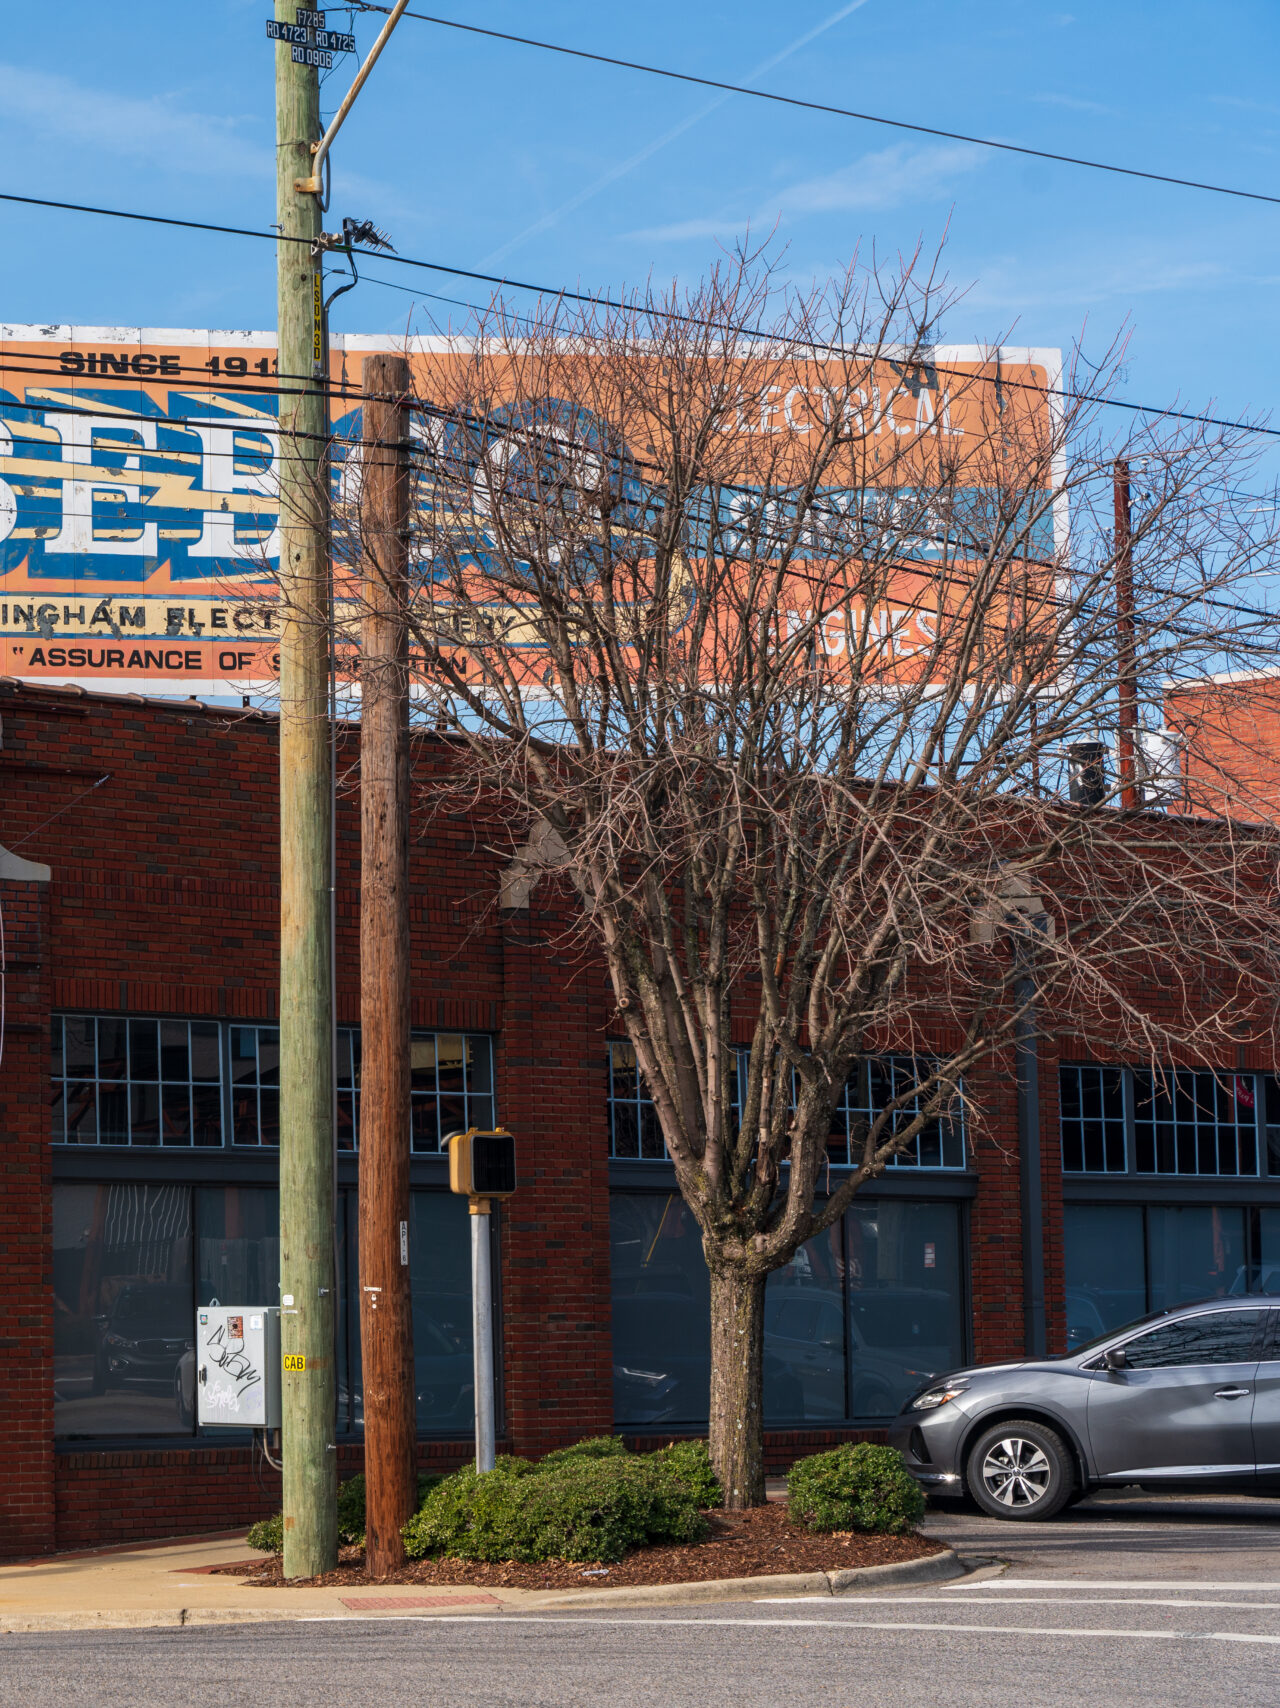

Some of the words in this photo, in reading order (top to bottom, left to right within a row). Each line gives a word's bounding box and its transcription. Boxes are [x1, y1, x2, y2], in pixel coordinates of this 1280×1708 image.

[267, 22, 279, 38] RD
[282, 24, 307, 43] 4723
[316, 31, 328, 47] RD
[331, 34, 355, 51] 4725
[292, 46, 304, 62] RD
[306, 51, 332, 68] 0906
[60, 351, 181, 376] SINCE
[711, 383, 965, 436] ELECTRICAL
[167, 606, 278, 632] ELECT
[219, 652, 256, 672] OF
[285, 1356, 304, 1370] CAB
